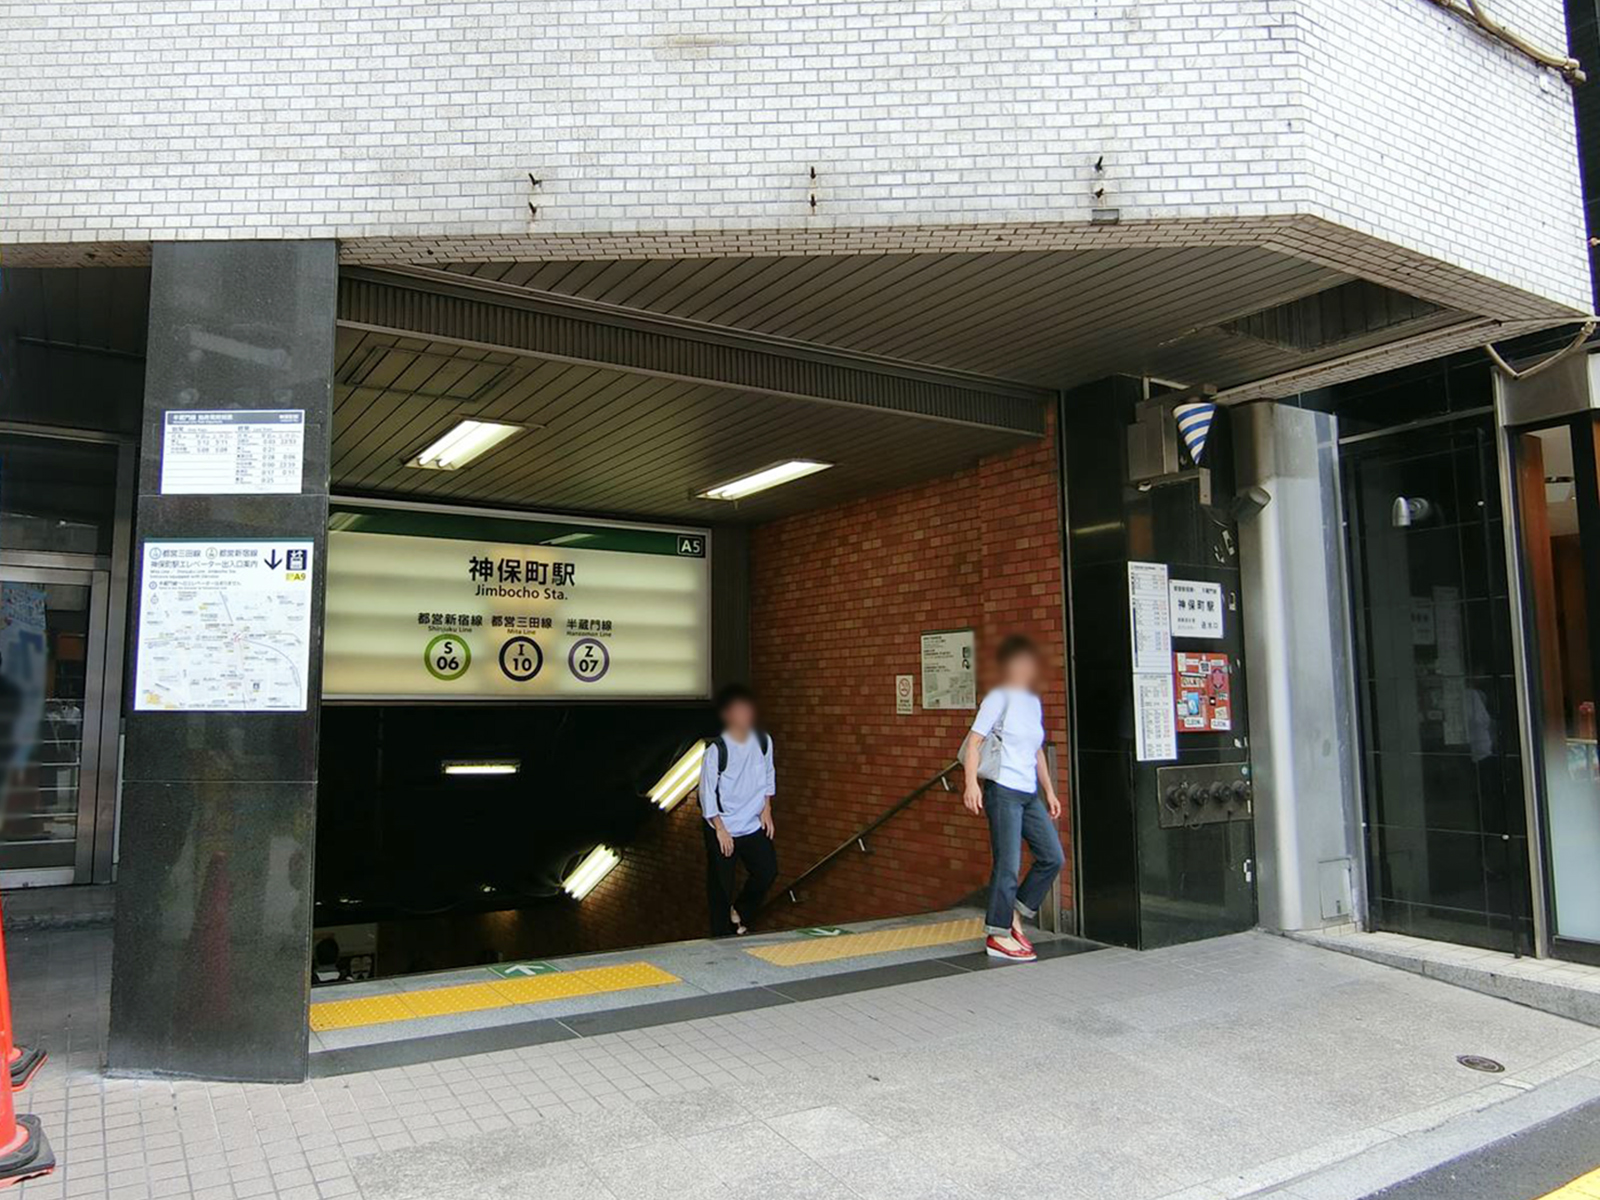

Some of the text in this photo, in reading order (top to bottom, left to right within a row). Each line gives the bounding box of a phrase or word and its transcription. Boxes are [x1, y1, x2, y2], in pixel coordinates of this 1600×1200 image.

[162, 549, 201, 558] 都営三田線
[680, 539, 701, 554] A5
[469, 556, 576, 587] 神保町駅
[475, 585, 568, 600] Jimbocho Sta.
[418, 612, 483, 627] 都営新宿線
[491, 615, 553, 629] 都営三田線
[566, 619, 612, 632] 半蔵門線
[428, 625, 455, 634] Shinjuku
[443, 641, 454, 654] S
[517, 644, 526, 656] I
[584, 646, 594, 658] Z
[436, 656, 459, 671] 06
[512, 657, 532, 672] 10
[578, 659, 598, 673] 07
